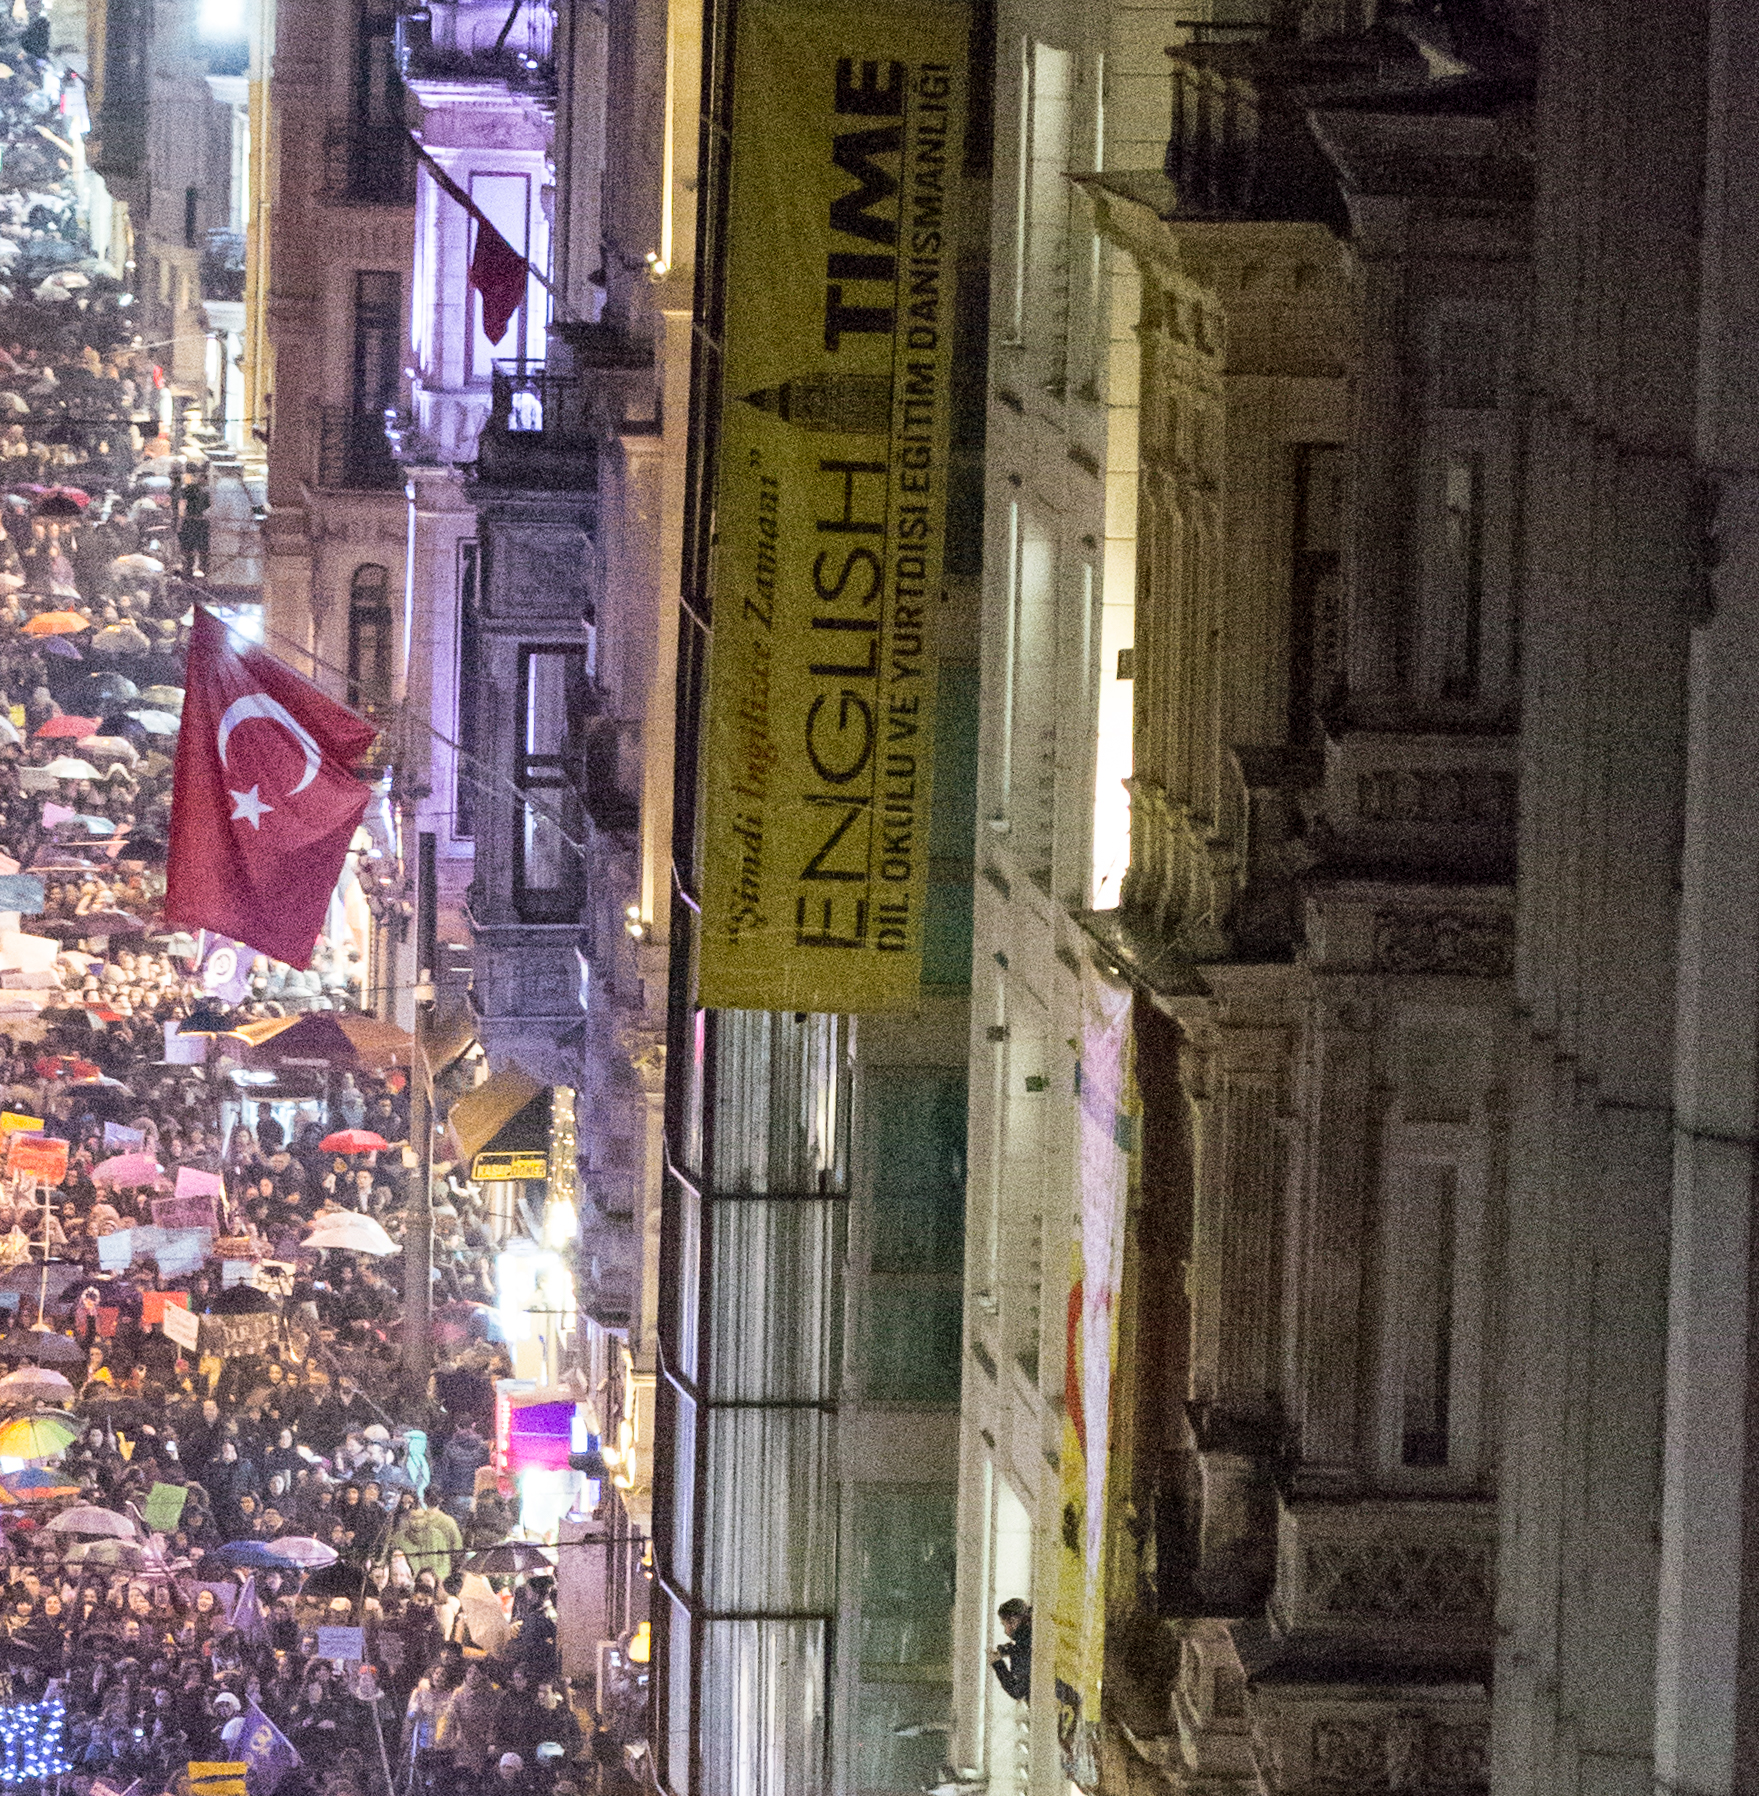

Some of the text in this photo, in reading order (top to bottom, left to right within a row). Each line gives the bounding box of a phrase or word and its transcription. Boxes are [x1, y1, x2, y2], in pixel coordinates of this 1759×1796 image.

[824, 56, 907, 350] TIME
[795, 460, 888, 948] ENGLISH
[889, 700, 918, 743] VE
[882, 758, 915, 884] OKULU
